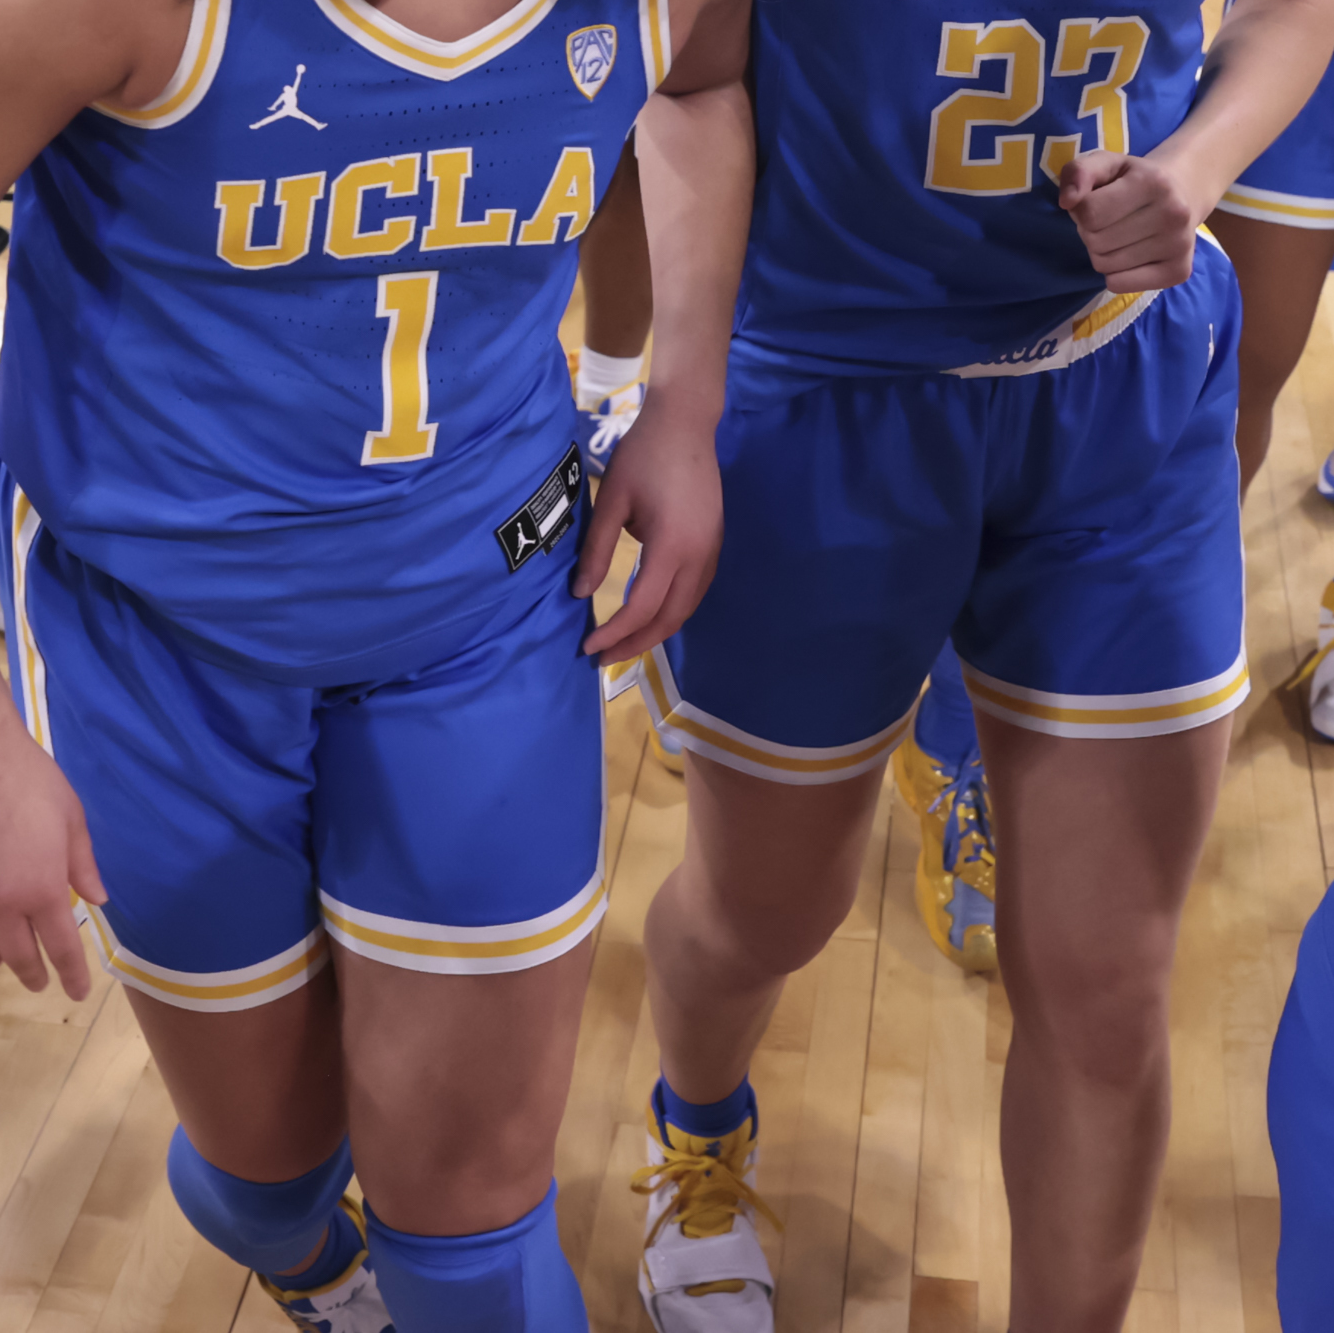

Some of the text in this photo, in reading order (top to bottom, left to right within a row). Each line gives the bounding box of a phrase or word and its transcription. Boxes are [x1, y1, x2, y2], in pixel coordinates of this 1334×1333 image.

[571, 29, 614, 73] PAC
[581, 56, 604, 84] 12
[924, 16, 1151, 196] 23
[214, 147, 595, 270] UCLA
[361, 270, 439, 466] 1
[567, 462, 581, 486] 42
